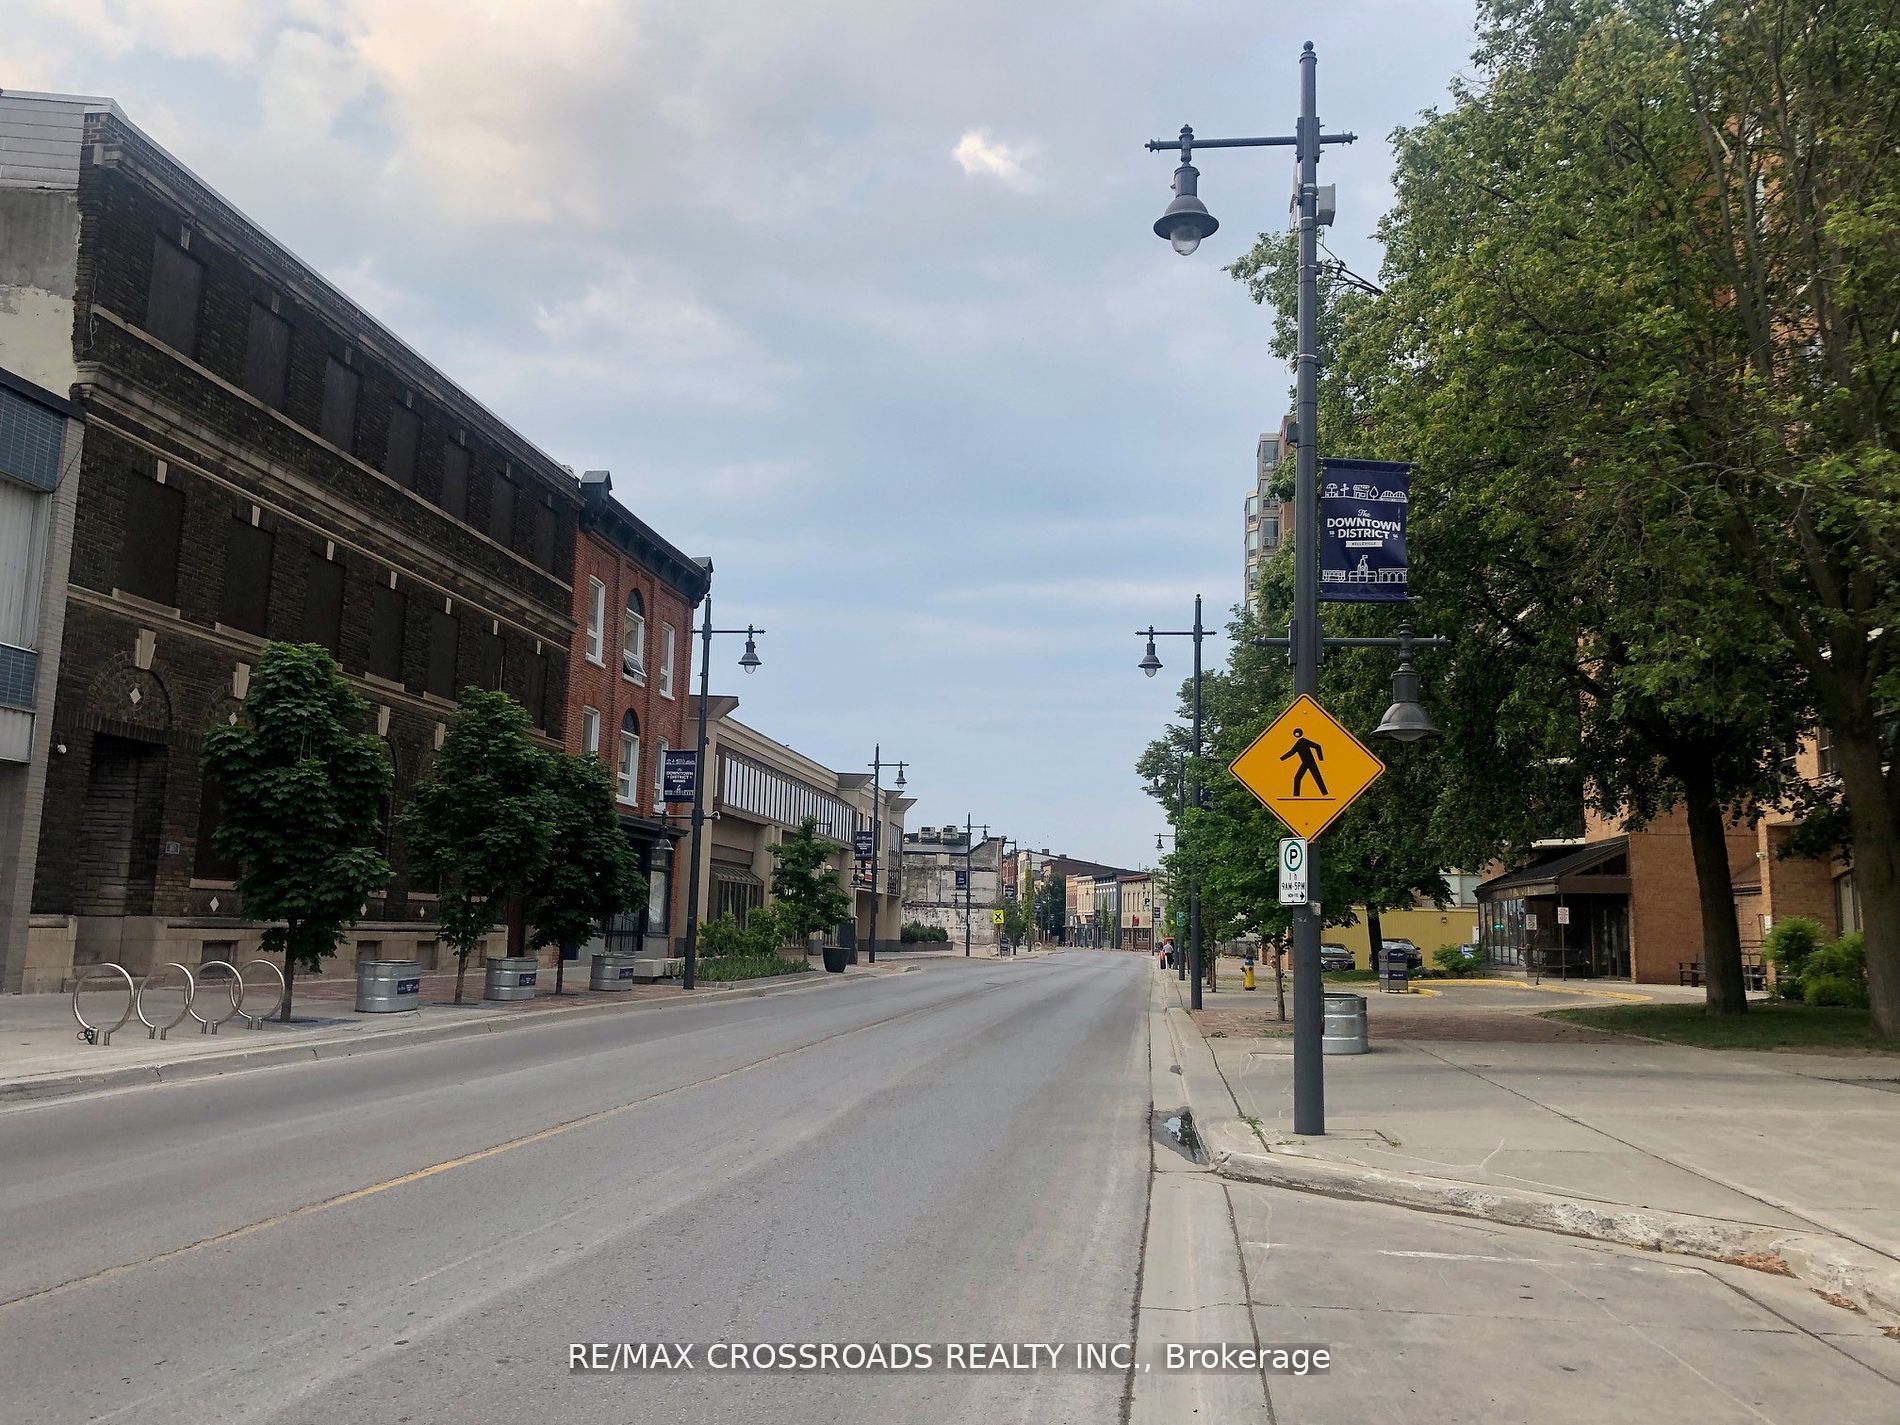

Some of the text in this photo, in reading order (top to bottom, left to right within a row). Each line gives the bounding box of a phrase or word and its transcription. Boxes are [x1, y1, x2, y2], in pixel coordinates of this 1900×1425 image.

[1357, 509, 1371, 518] The
[1327, 517, 1401, 532] DOWNTOWN
[1338, 529, 1390, 539] DISTRICT
[1290, 849, 1298, 864] P
[1282, 882, 1305, 890] 9AM-5PM
